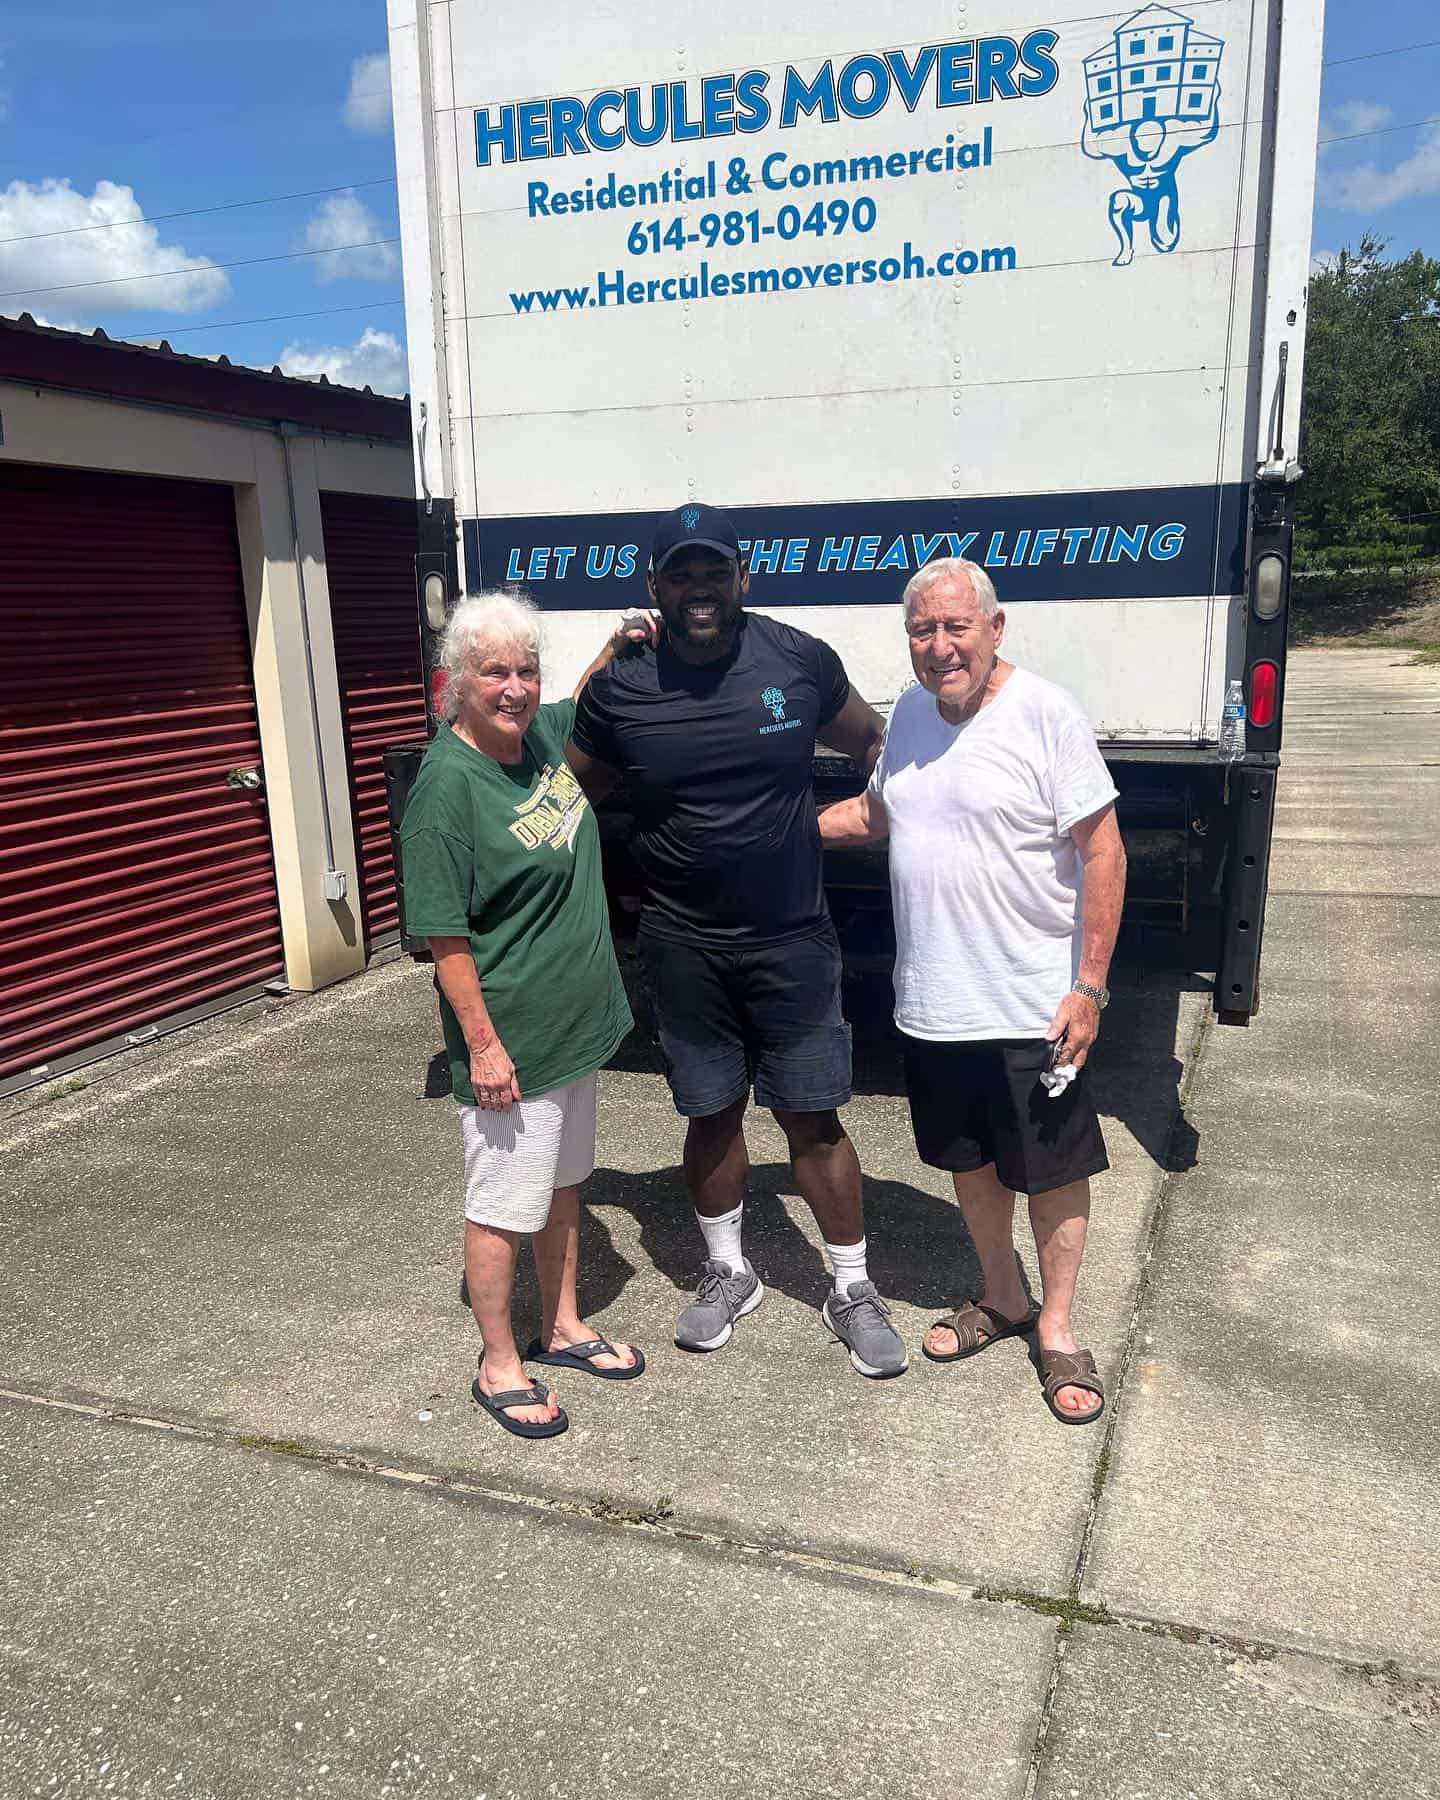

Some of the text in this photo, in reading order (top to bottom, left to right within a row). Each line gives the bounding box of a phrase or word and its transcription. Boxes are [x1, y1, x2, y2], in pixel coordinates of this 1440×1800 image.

[474, 28, 1060, 167] HERCULES MOVERS
[527, 128, 993, 217] Residential & Commercial
[627, 197, 877, 255] 614-981-0490
[509, 242, 1016, 311] www.Herculesmoversoh.com
[506, 546, 576, 580] LET
[585, 544, 639, 579] US
[738, 537, 809, 574] HE
[817, 532, 980, 572] HEAVY
[984, 522, 1187, 567] LIFTING
